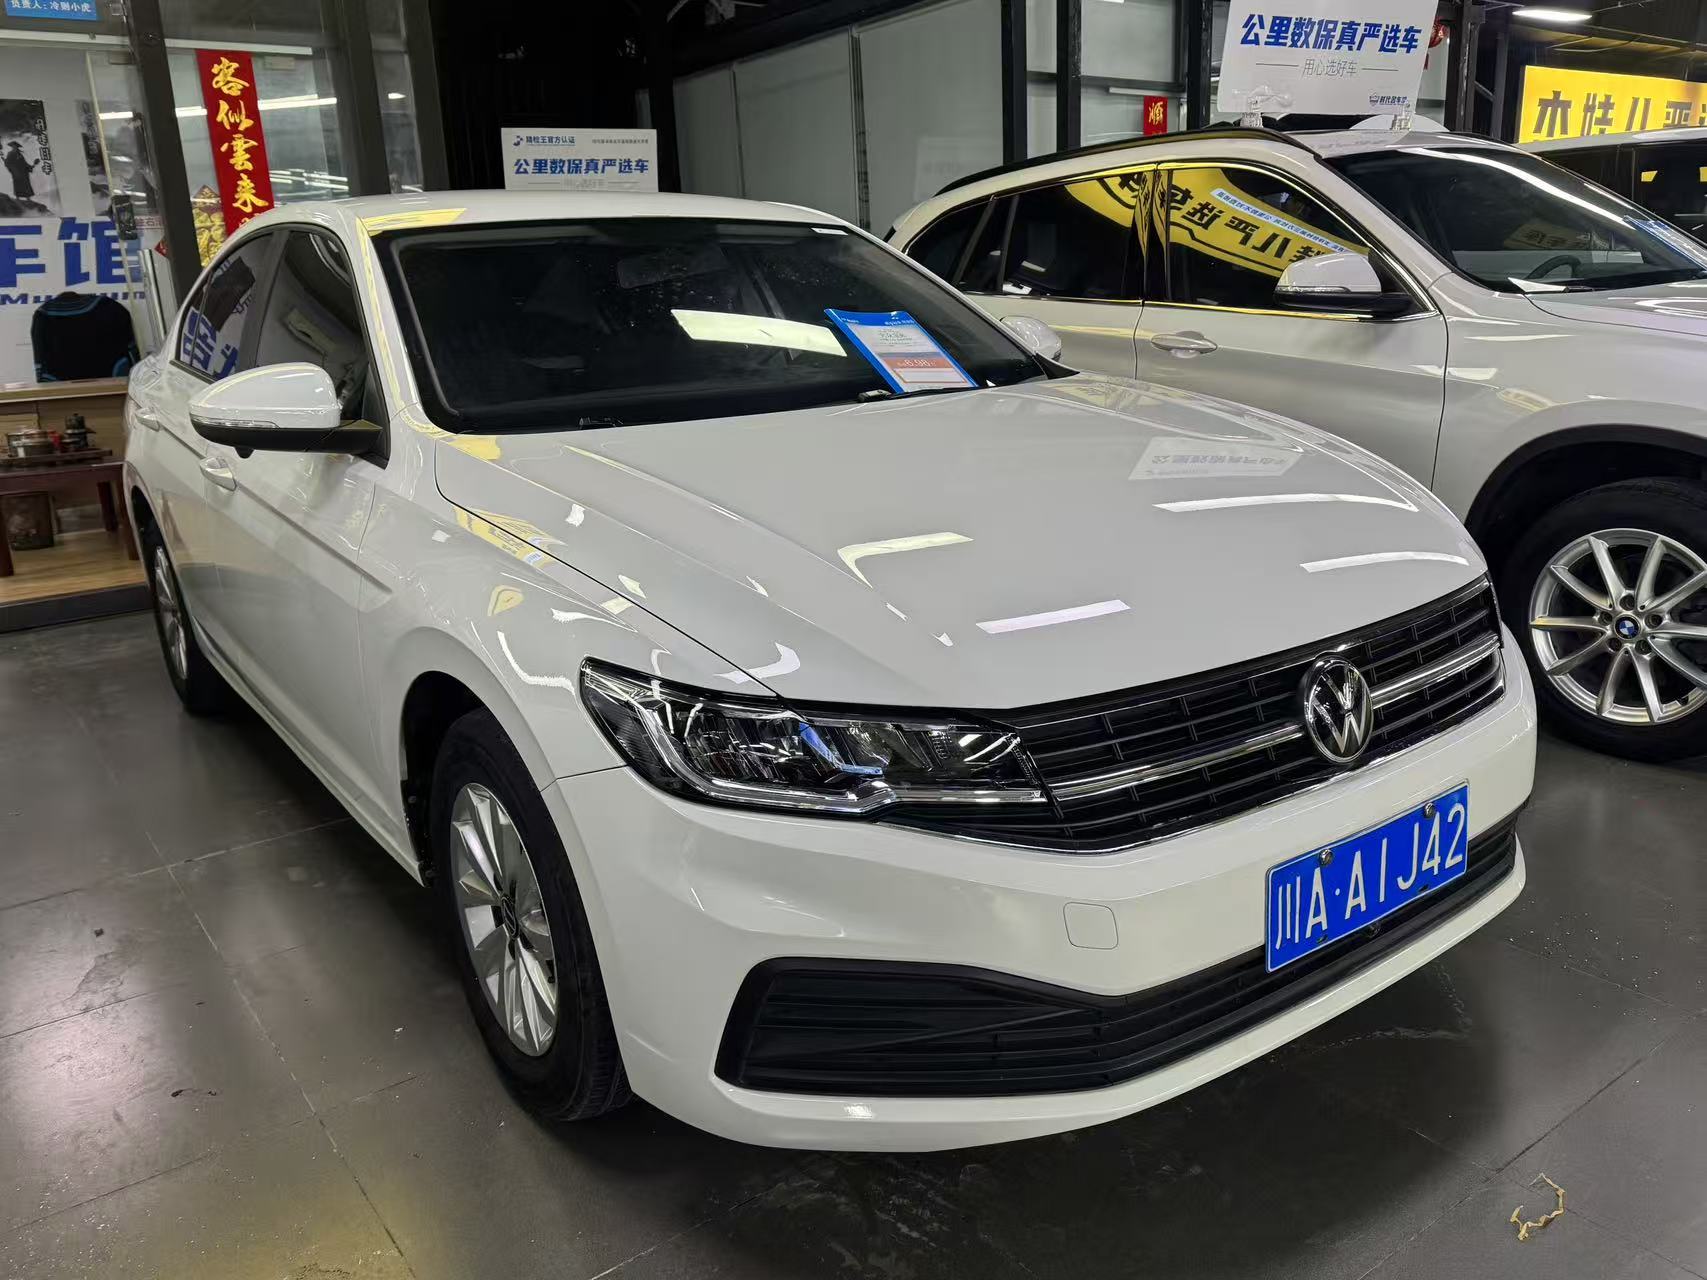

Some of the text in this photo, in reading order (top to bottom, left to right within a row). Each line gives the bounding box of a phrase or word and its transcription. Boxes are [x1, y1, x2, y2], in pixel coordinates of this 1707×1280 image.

[1240, 13, 1422, 54] 公里数保真严选车
[513, 158, 650, 175] 公里数保真严选车
